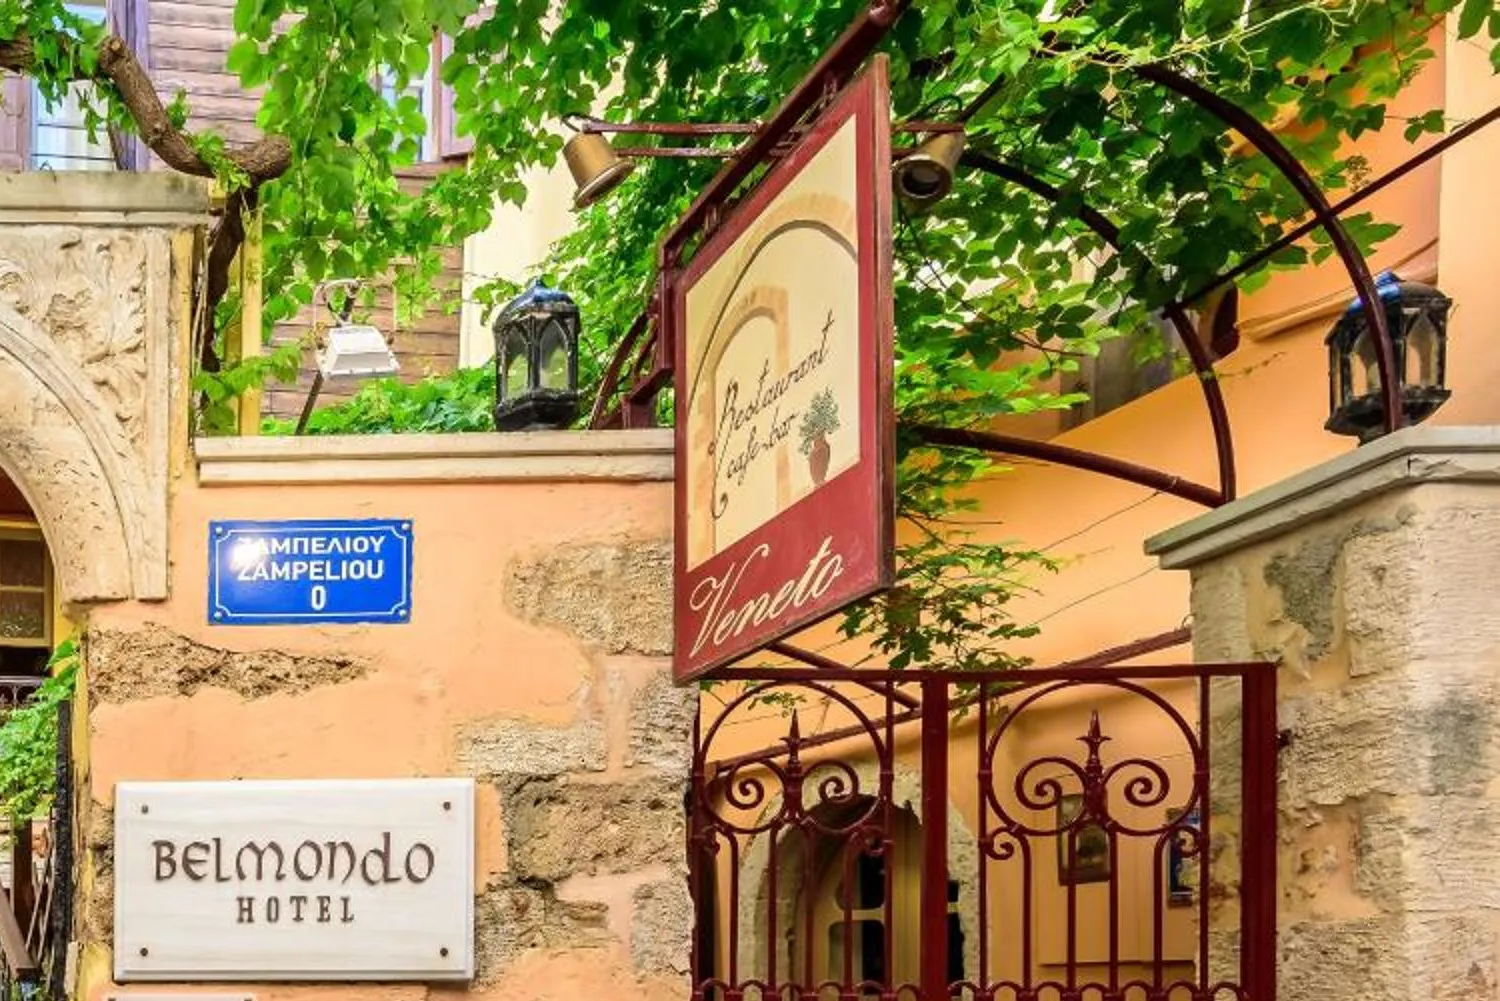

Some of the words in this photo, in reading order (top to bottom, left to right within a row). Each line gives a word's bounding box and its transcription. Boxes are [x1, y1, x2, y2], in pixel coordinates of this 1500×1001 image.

[707, 309, 835, 519] Restaurant
[238, 535, 385, 555] ΑΜΠΕΛΙΟΥ
[237, 559, 384, 581] ZAMPELIOU
[688, 535, 844, 659] Veneto
[236, 896, 355, 923] HOTEL
